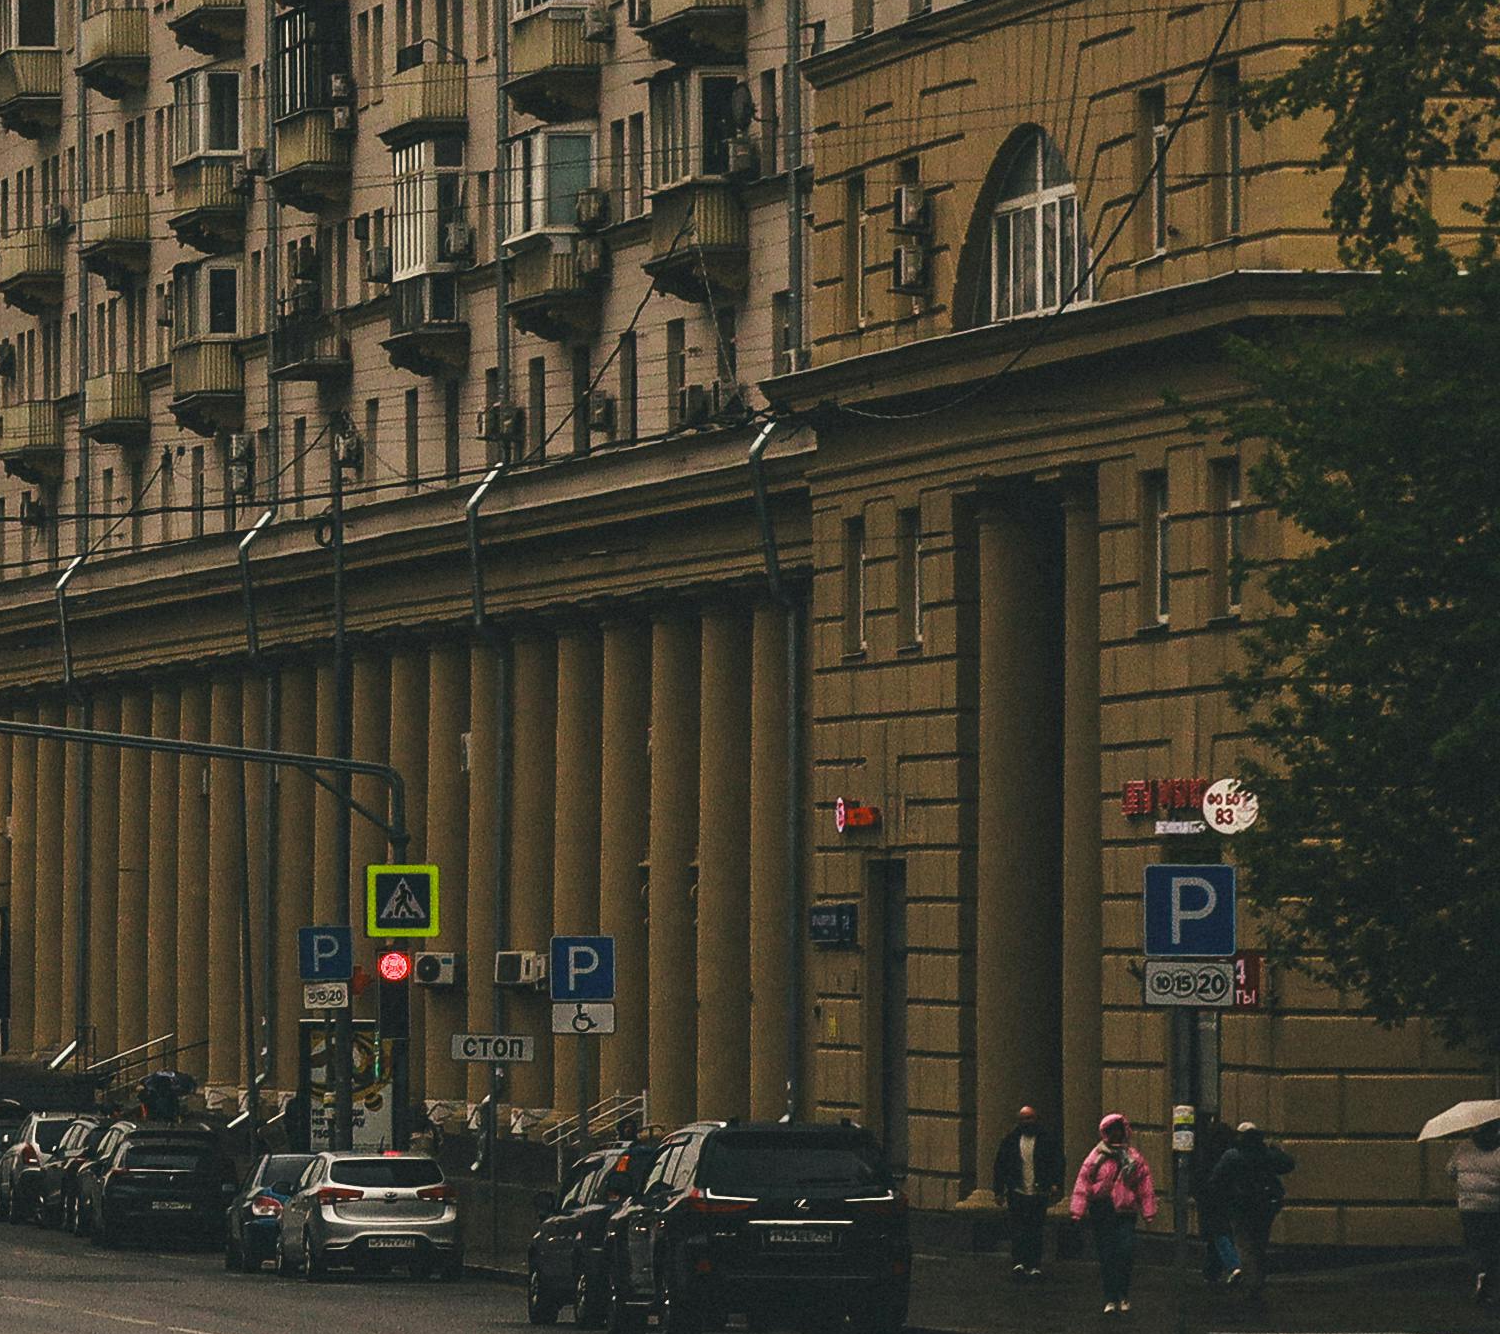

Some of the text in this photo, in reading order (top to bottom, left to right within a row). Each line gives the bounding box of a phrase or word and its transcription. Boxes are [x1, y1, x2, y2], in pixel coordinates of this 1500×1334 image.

[1215, 808, 1234, 825] 83
[1171, 876, 1218, 945] P
[314, 934, 340, 972] P
[568, 945, 600, 991] P
[1174, 975, 1191, 991] 15
[1197, 974, 1226, 994] 20
[329, 990, 343, 1001] 20
[462, 1037, 524, 1059] СТОП
